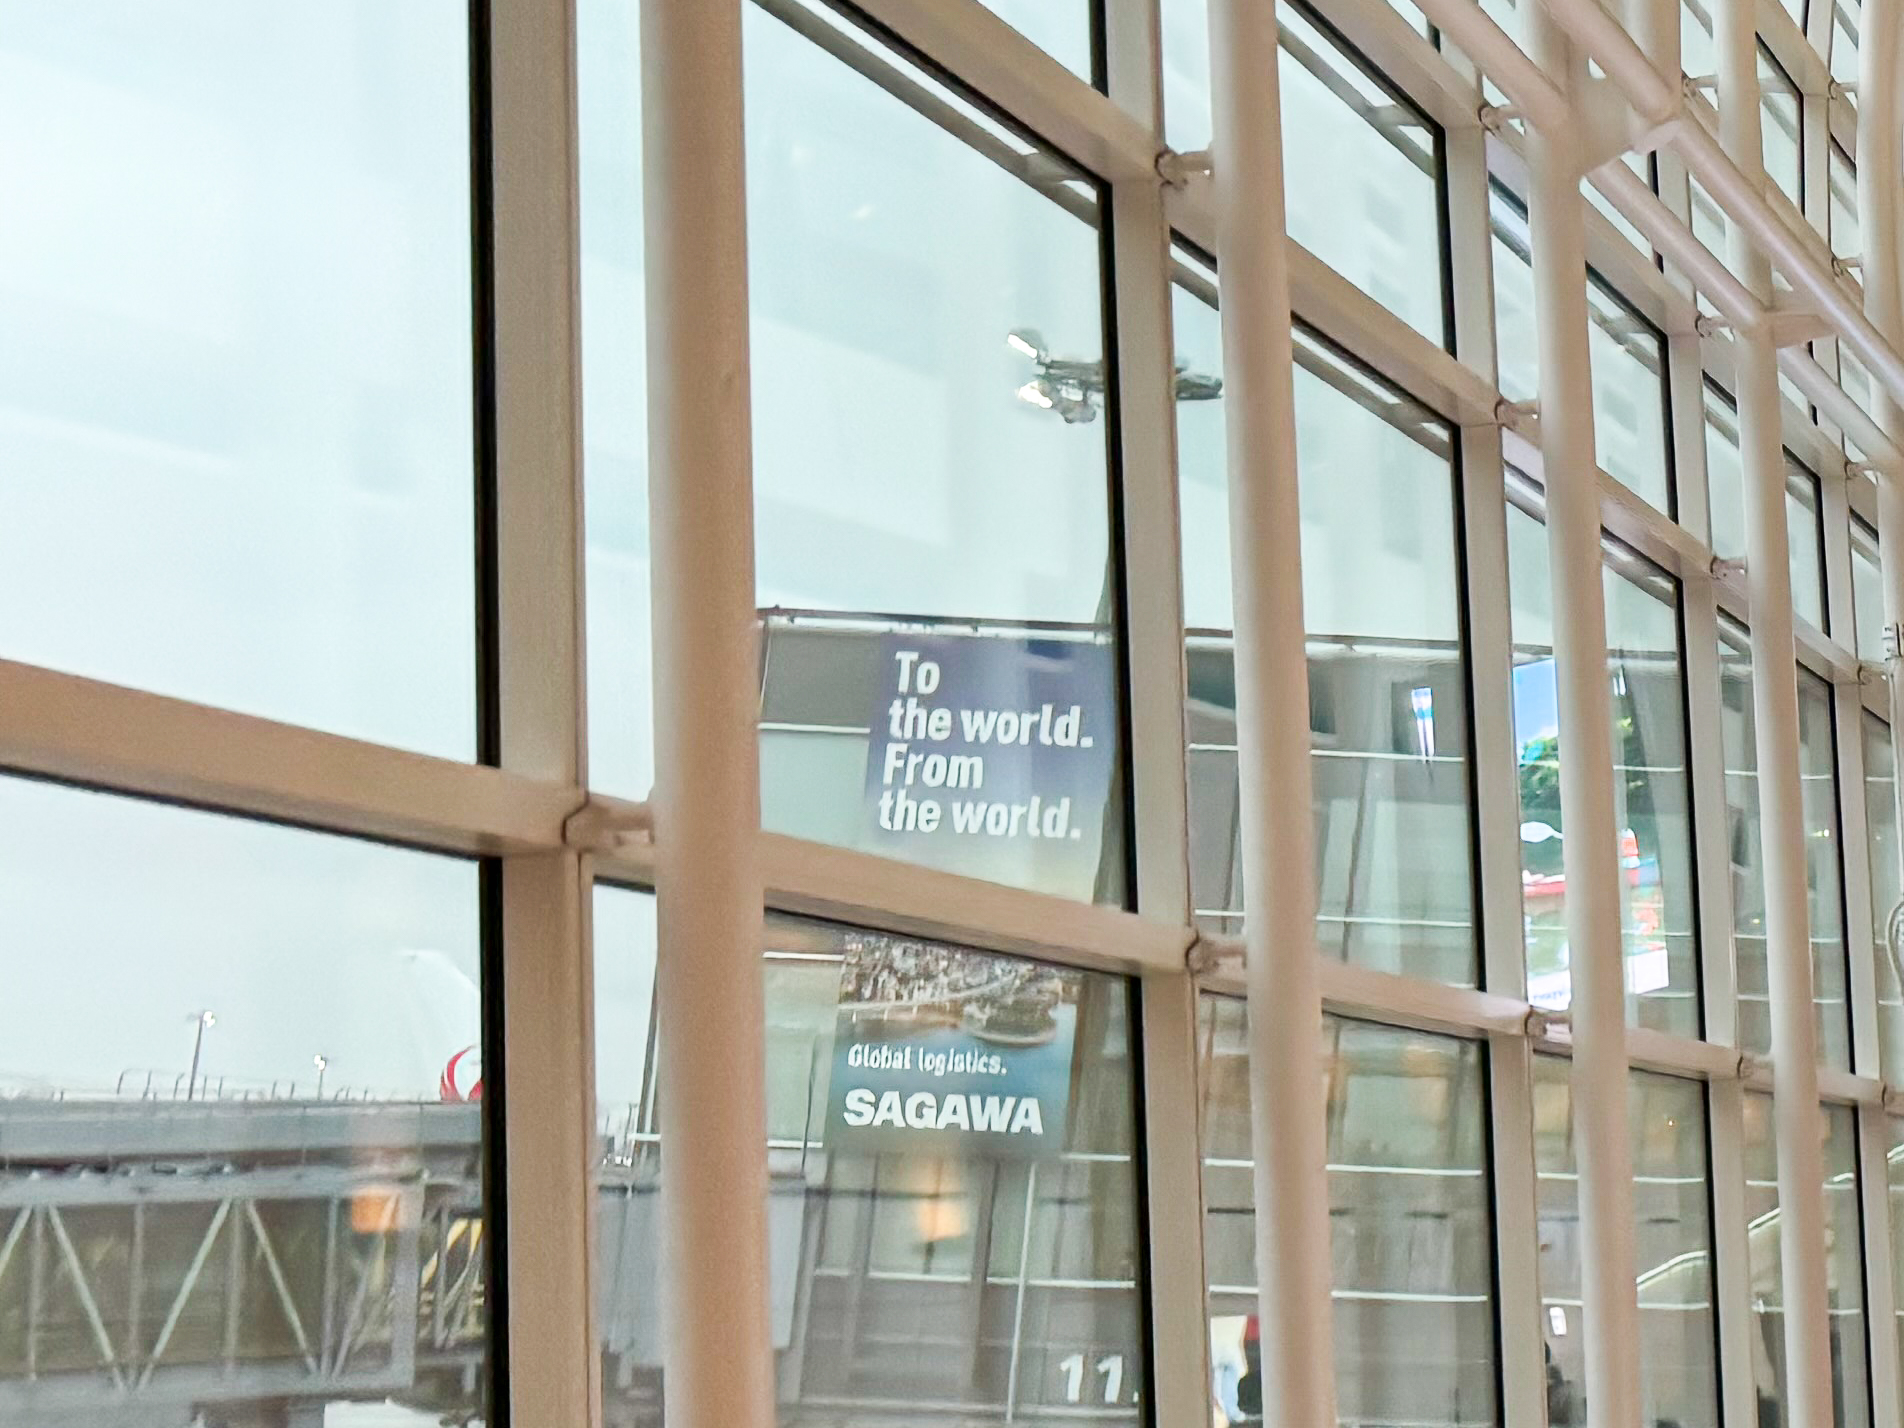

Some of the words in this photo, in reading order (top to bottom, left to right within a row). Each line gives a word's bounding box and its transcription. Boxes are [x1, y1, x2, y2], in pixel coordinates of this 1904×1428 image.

[895, 651, 941, 695] To
[888, 697, 952, 741] the
[960, 704, 1094, 748] world.
[882, 742, 984, 789] From
[878, 788, 942, 833] the
[952, 795, 1081, 839] world.
[848, 1044, 911, 1069] Global
[843, 1088, 1043, 1135] SAGAWA
